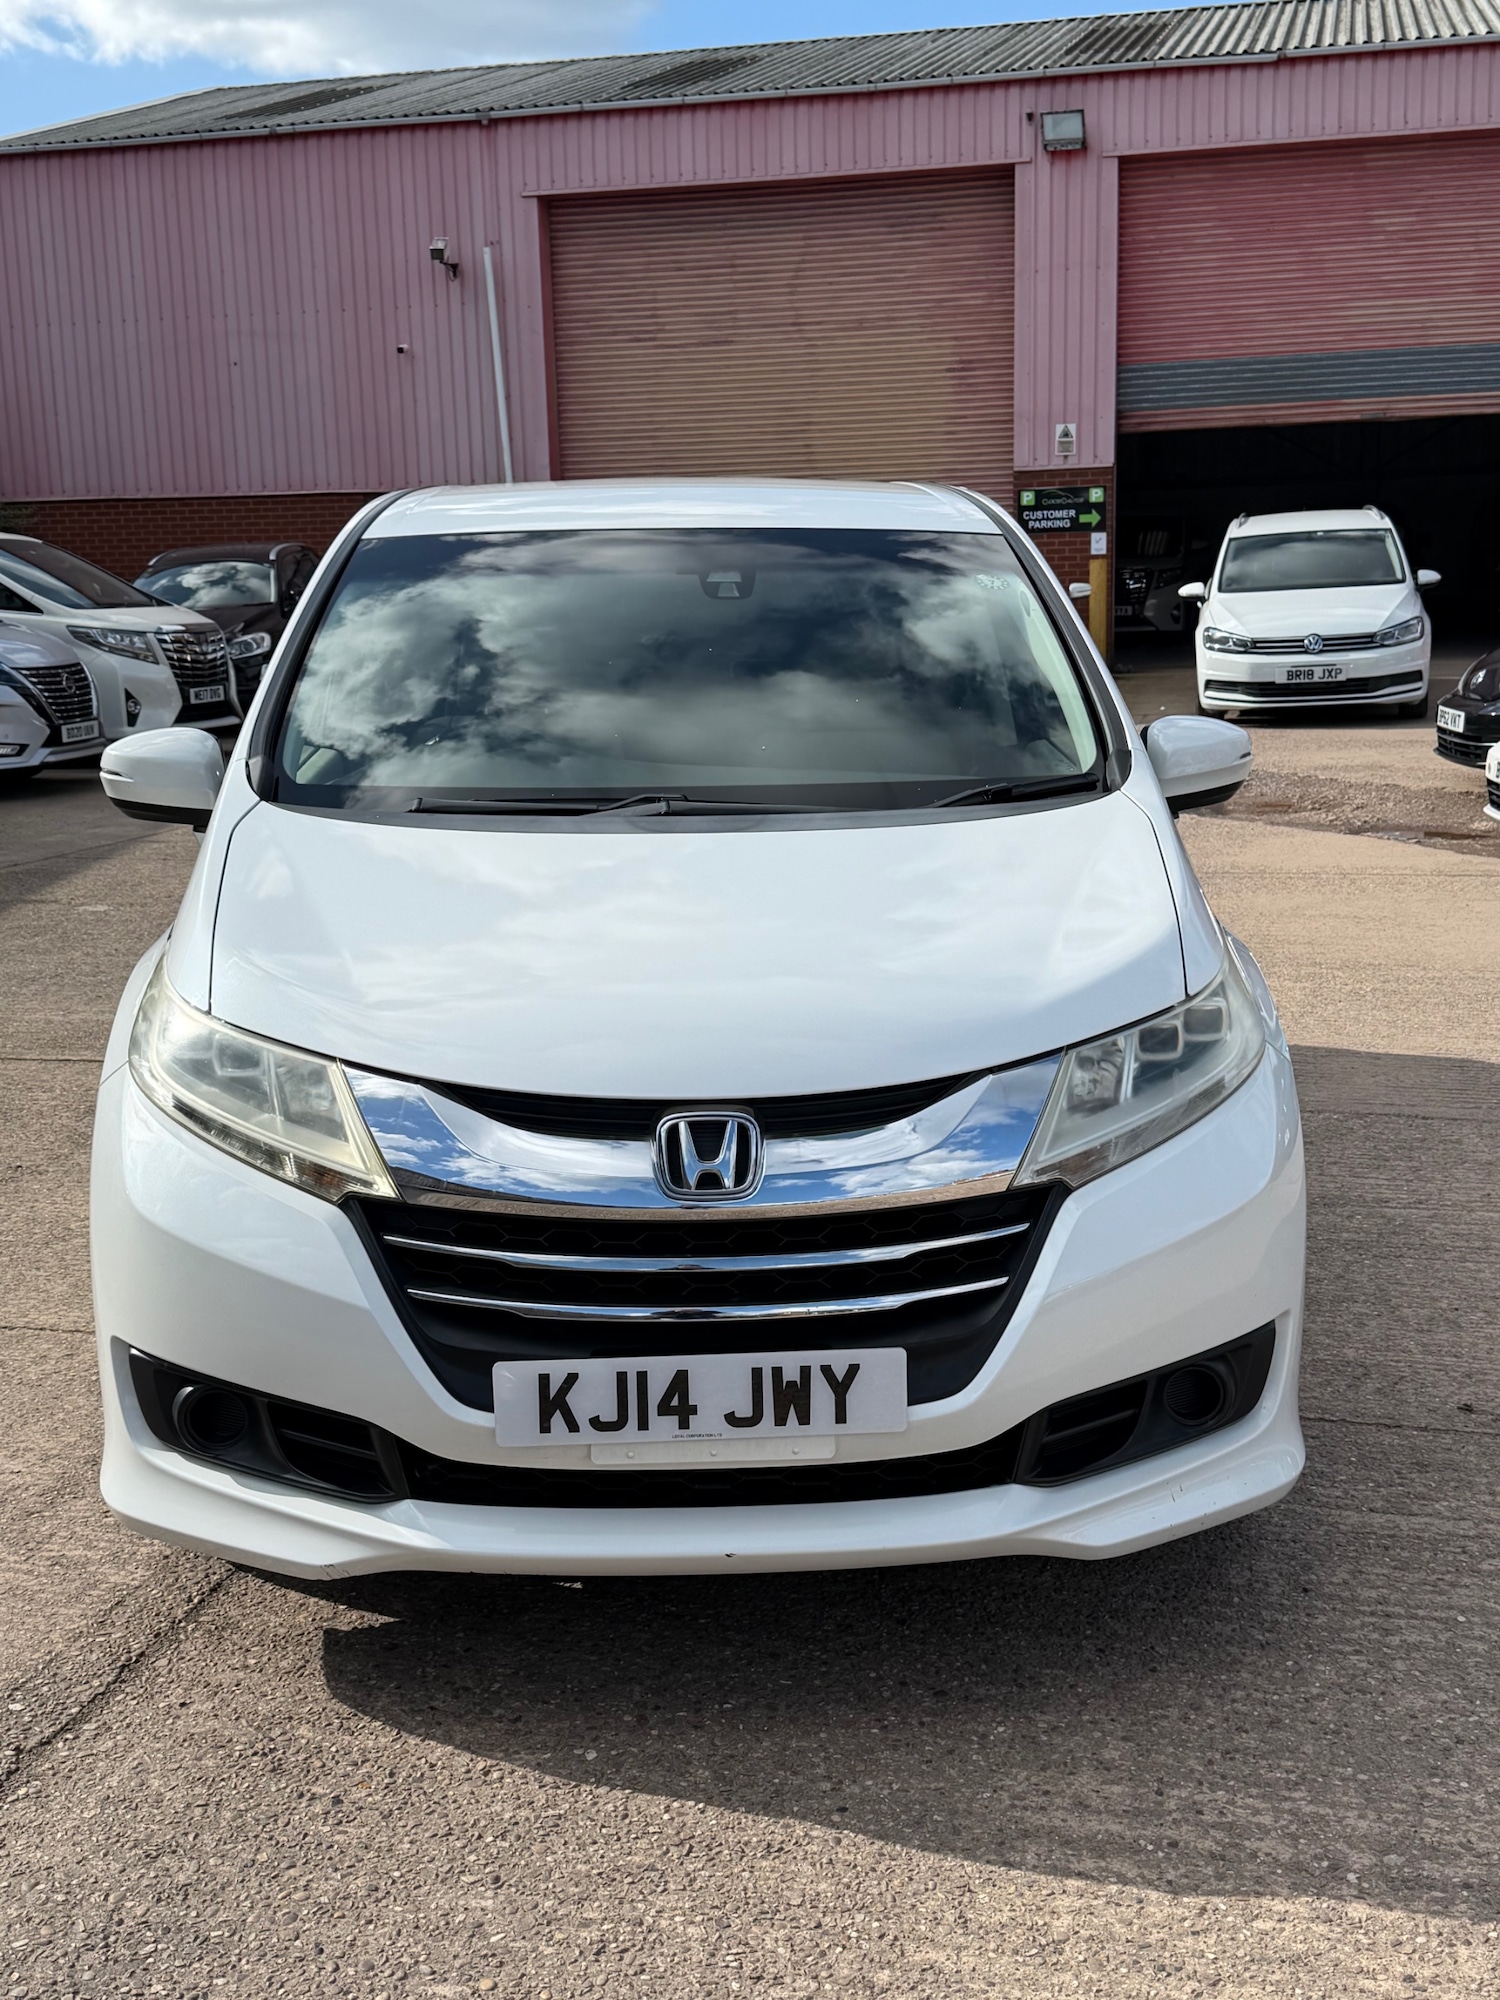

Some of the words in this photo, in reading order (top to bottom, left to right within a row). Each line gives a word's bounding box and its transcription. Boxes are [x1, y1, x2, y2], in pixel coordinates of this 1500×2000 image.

[1023, 509, 1076, 520] CUSTOMER
[1028, 519, 1071, 529] PARKING
[1286, 669, 1314, 681] BR18
[1318, 667, 1342, 680] JXP
[538, 1369, 698, 1434] KJ14
[723, 1363, 861, 1429] JWY
